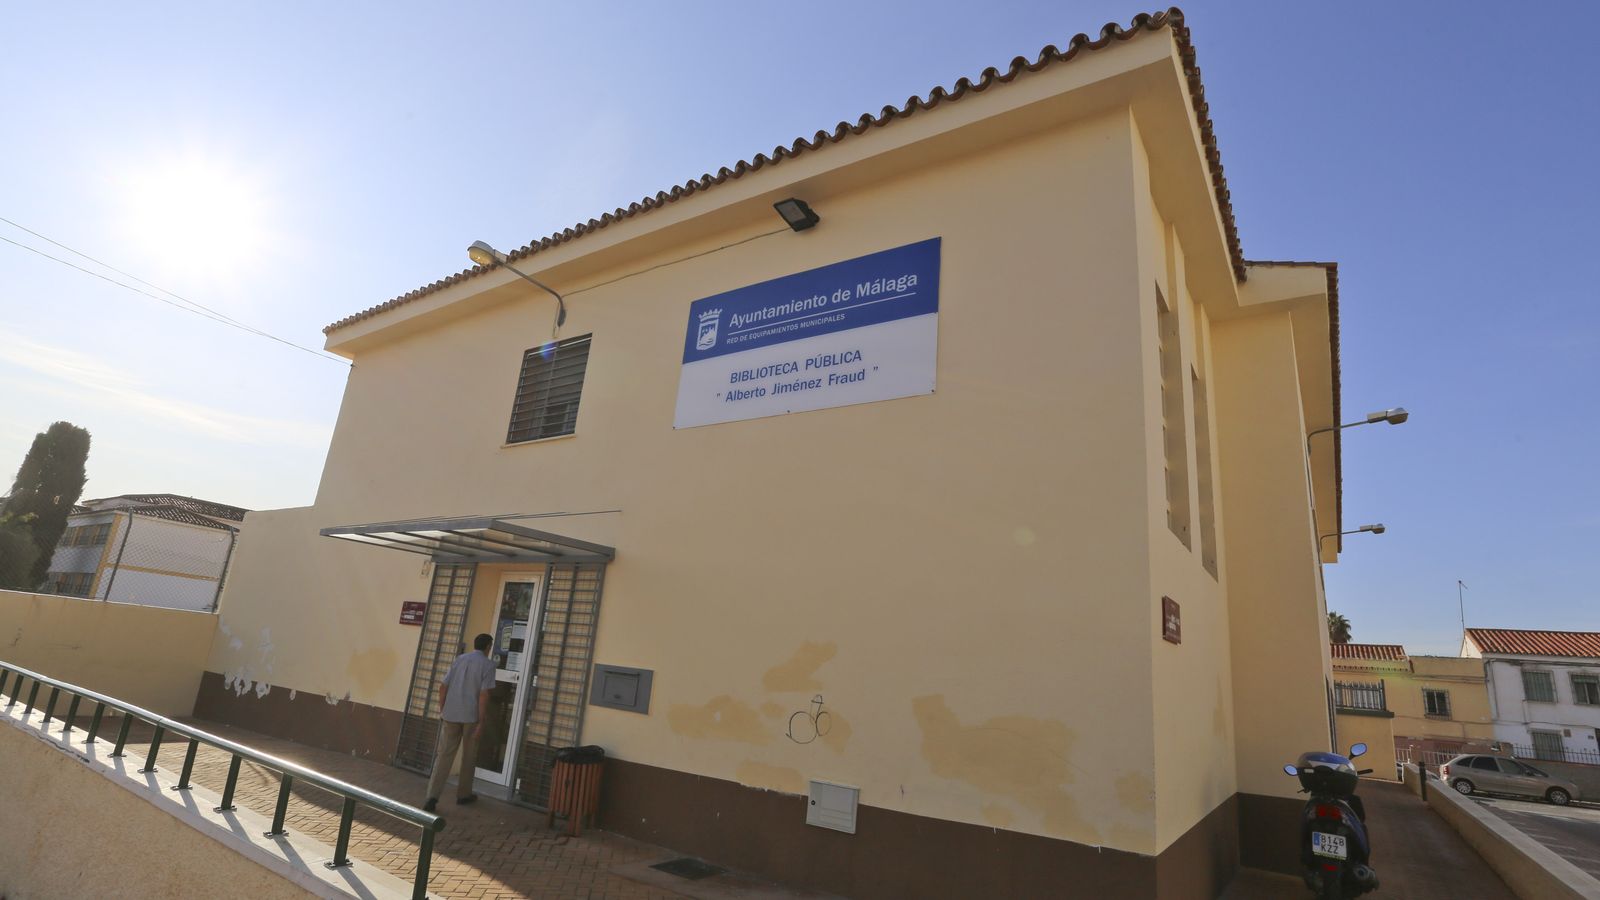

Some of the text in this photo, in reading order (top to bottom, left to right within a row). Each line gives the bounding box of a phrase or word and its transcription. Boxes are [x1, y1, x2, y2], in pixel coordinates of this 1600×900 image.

[729, 274, 918, 328] Ayuntamiento de Málaga
[726, 313, 846, 345] RED DE EQUIPAMIENTOS MUNICIPALES
[730, 350, 862, 383] BIBLIOTECA PÚBLICA
[725, 387, 766, 403] Alberto
[771, 378, 822, 396] Jiménez
[828, 369, 866, 386] Fraud
[1321, 835, 1344, 846] 8148
[1321, 844, 1339, 854] KZZ
